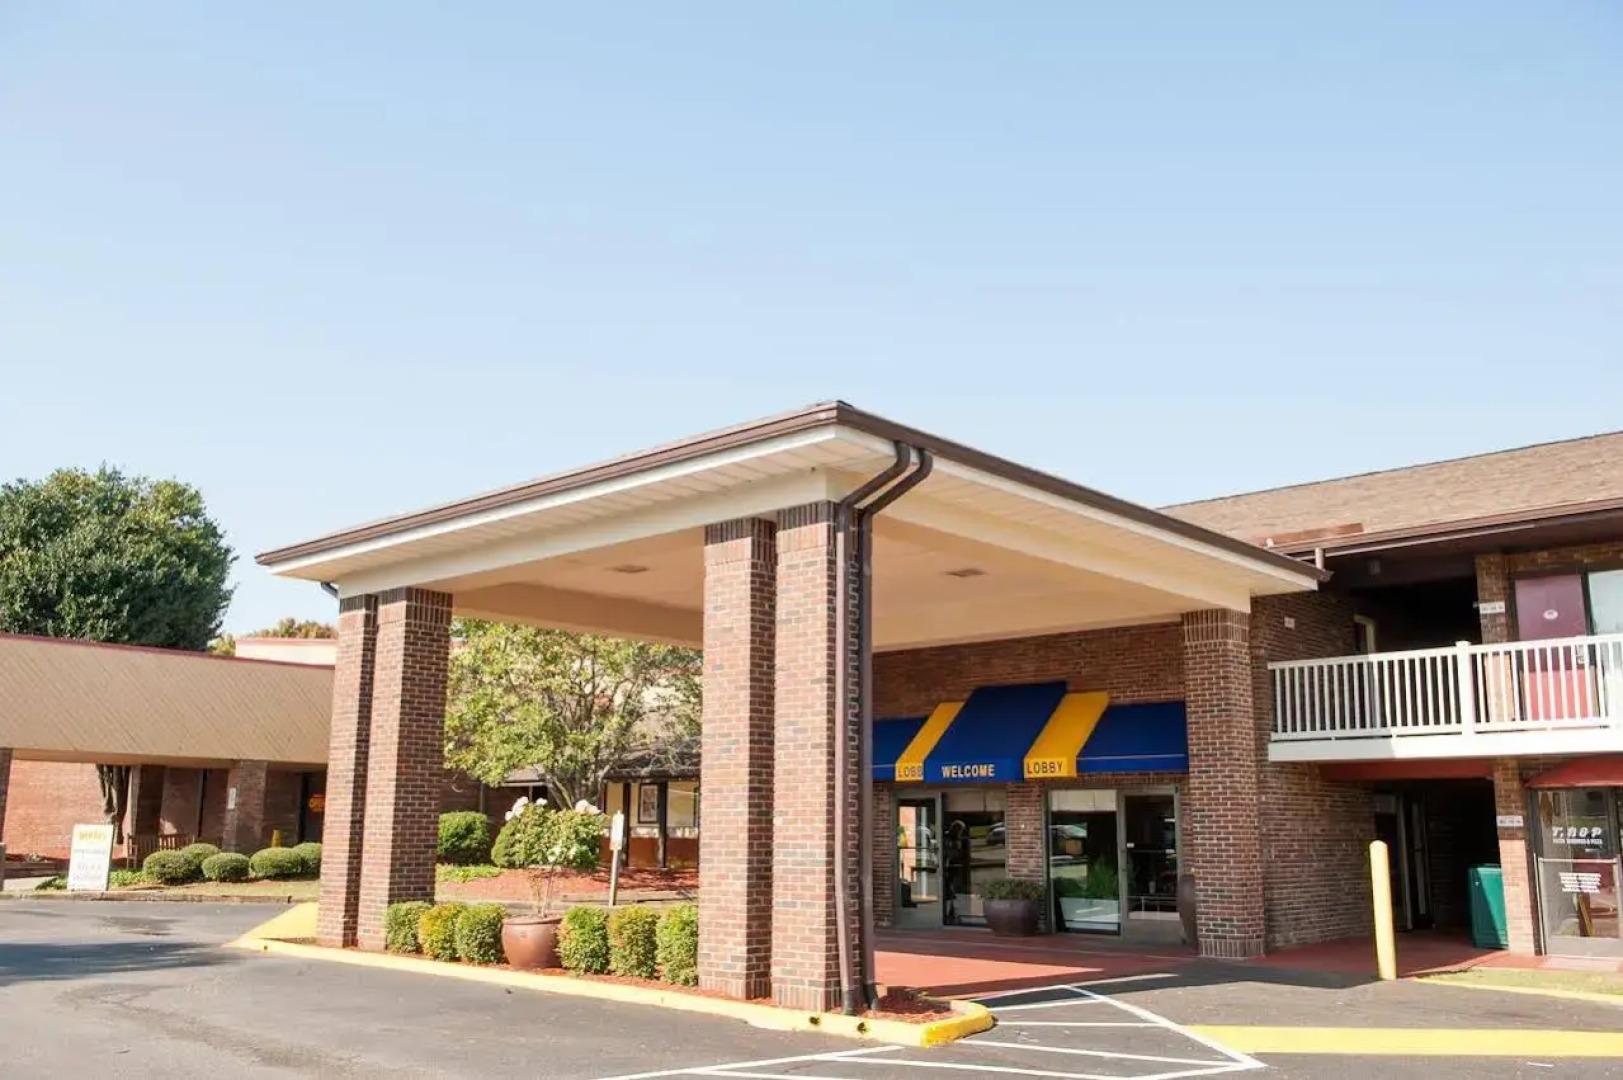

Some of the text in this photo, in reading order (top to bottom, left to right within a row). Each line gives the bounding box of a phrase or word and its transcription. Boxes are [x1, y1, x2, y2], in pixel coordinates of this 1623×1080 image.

[897, 765, 924, 778] LOBB
[941, 764, 996, 779] WELCOME
[1026, 761, 1063, 775] LOBBY
